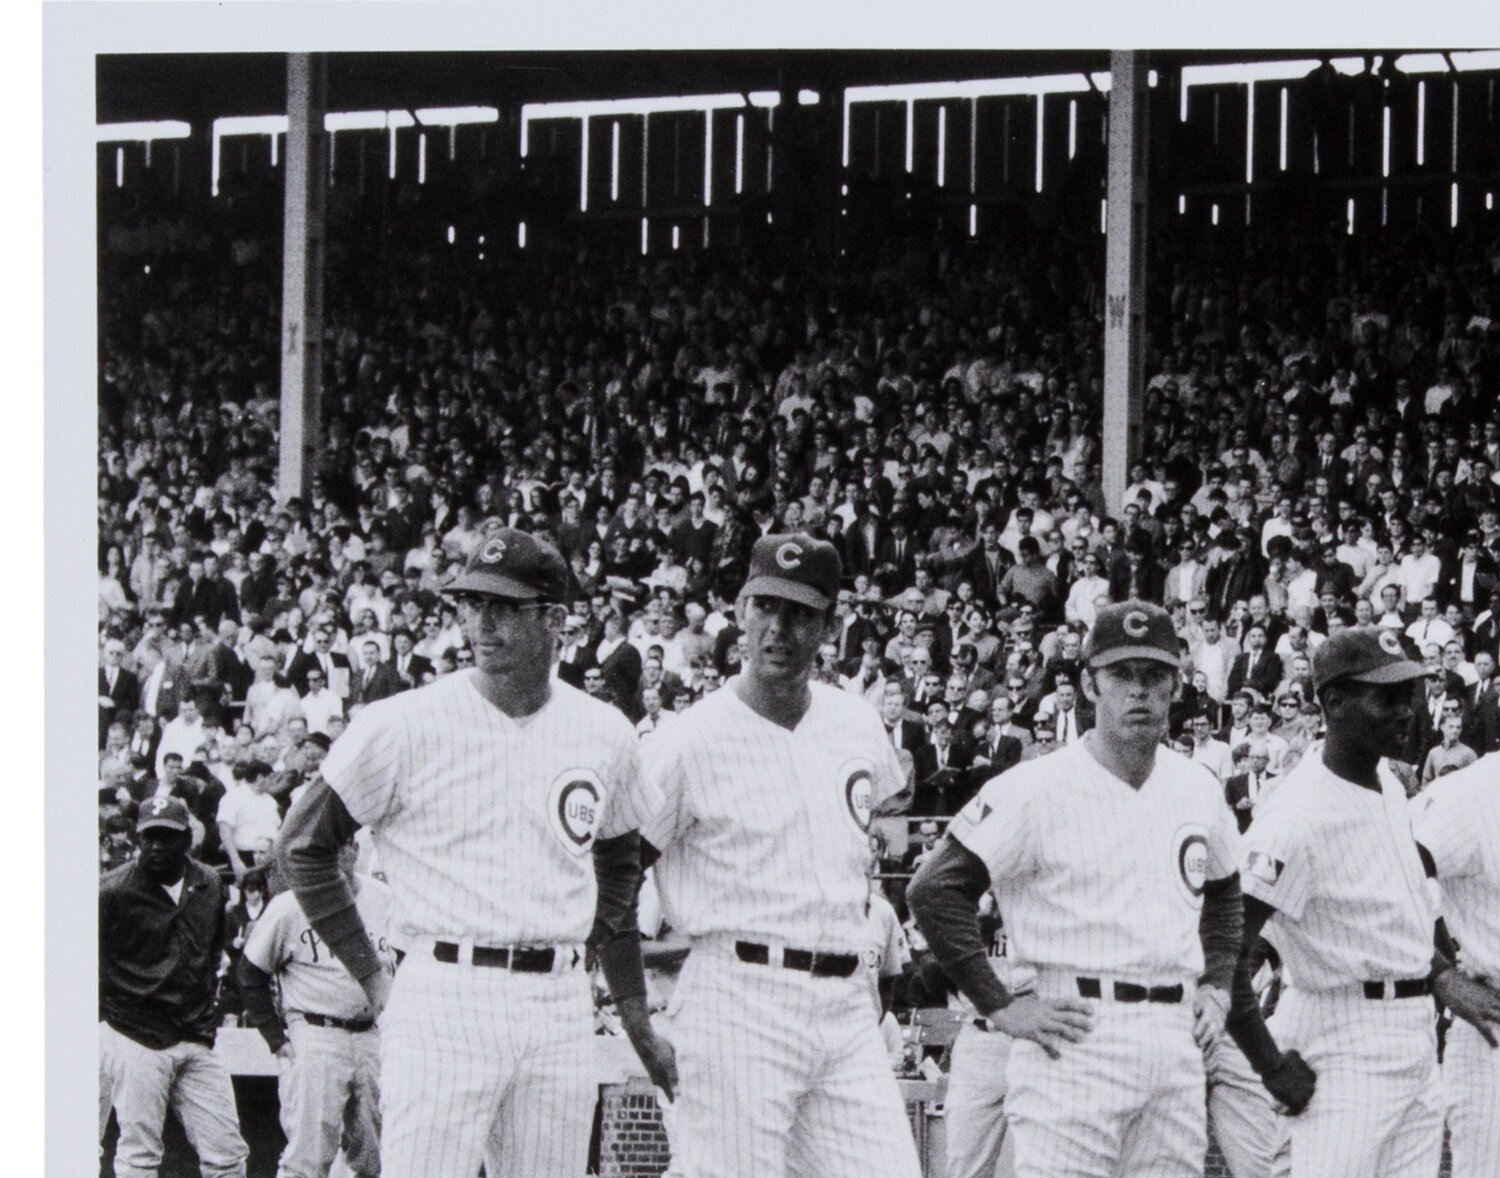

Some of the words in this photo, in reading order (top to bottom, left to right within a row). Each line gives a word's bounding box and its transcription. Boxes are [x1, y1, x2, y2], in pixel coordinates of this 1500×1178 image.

[480, 539, 506, 563] C
[775, 542, 803, 570] C
[1123, 611, 1149, 638] C
[1379, 630, 1400, 655] C
[151, 798, 169, 815] P
[845, 768, 873, 834] CUB
[1179, 834, 1209, 897] CUB
